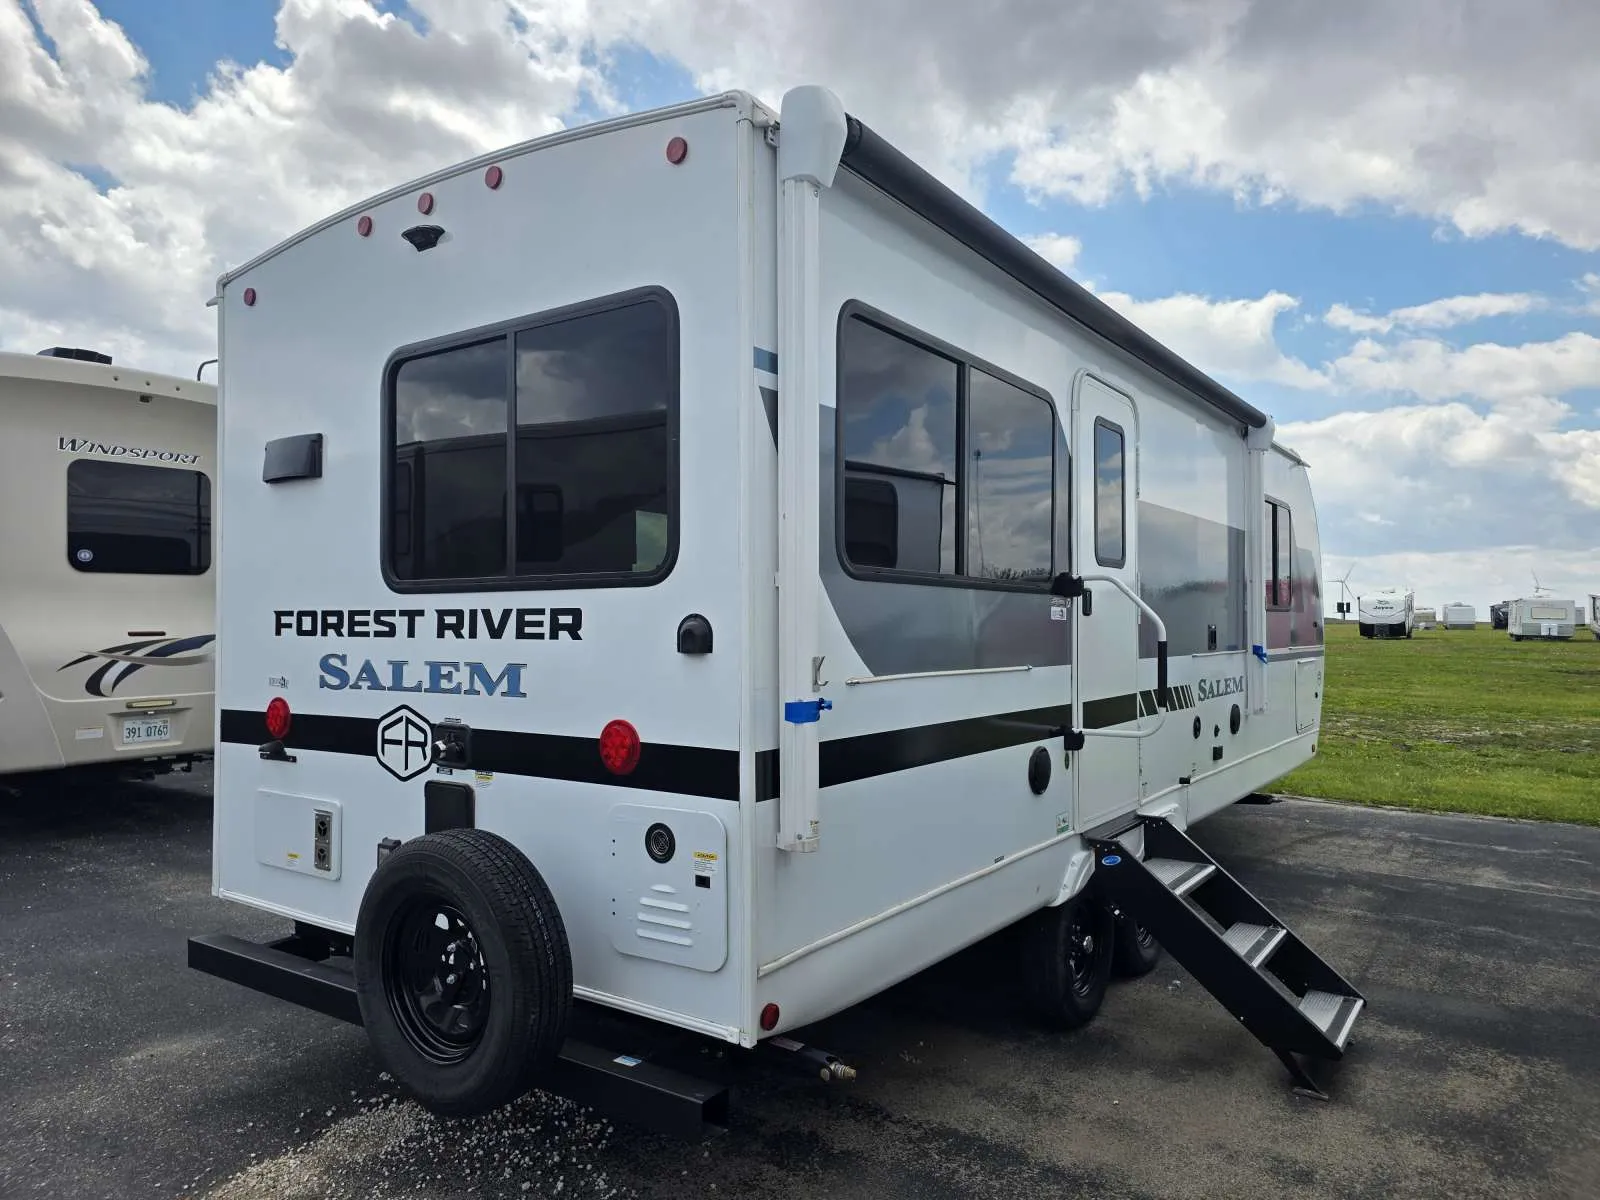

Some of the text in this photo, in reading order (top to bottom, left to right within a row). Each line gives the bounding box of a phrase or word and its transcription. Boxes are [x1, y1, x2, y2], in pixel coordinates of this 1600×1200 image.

[57, 436, 202, 465] WINDSPORT
[273, 607, 583, 640] FOREST RIVER
[319, 653, 527, 698] SALEM
[1198, 675, 1244, 702] SALEM
[126, 727, 142, 738] 391
